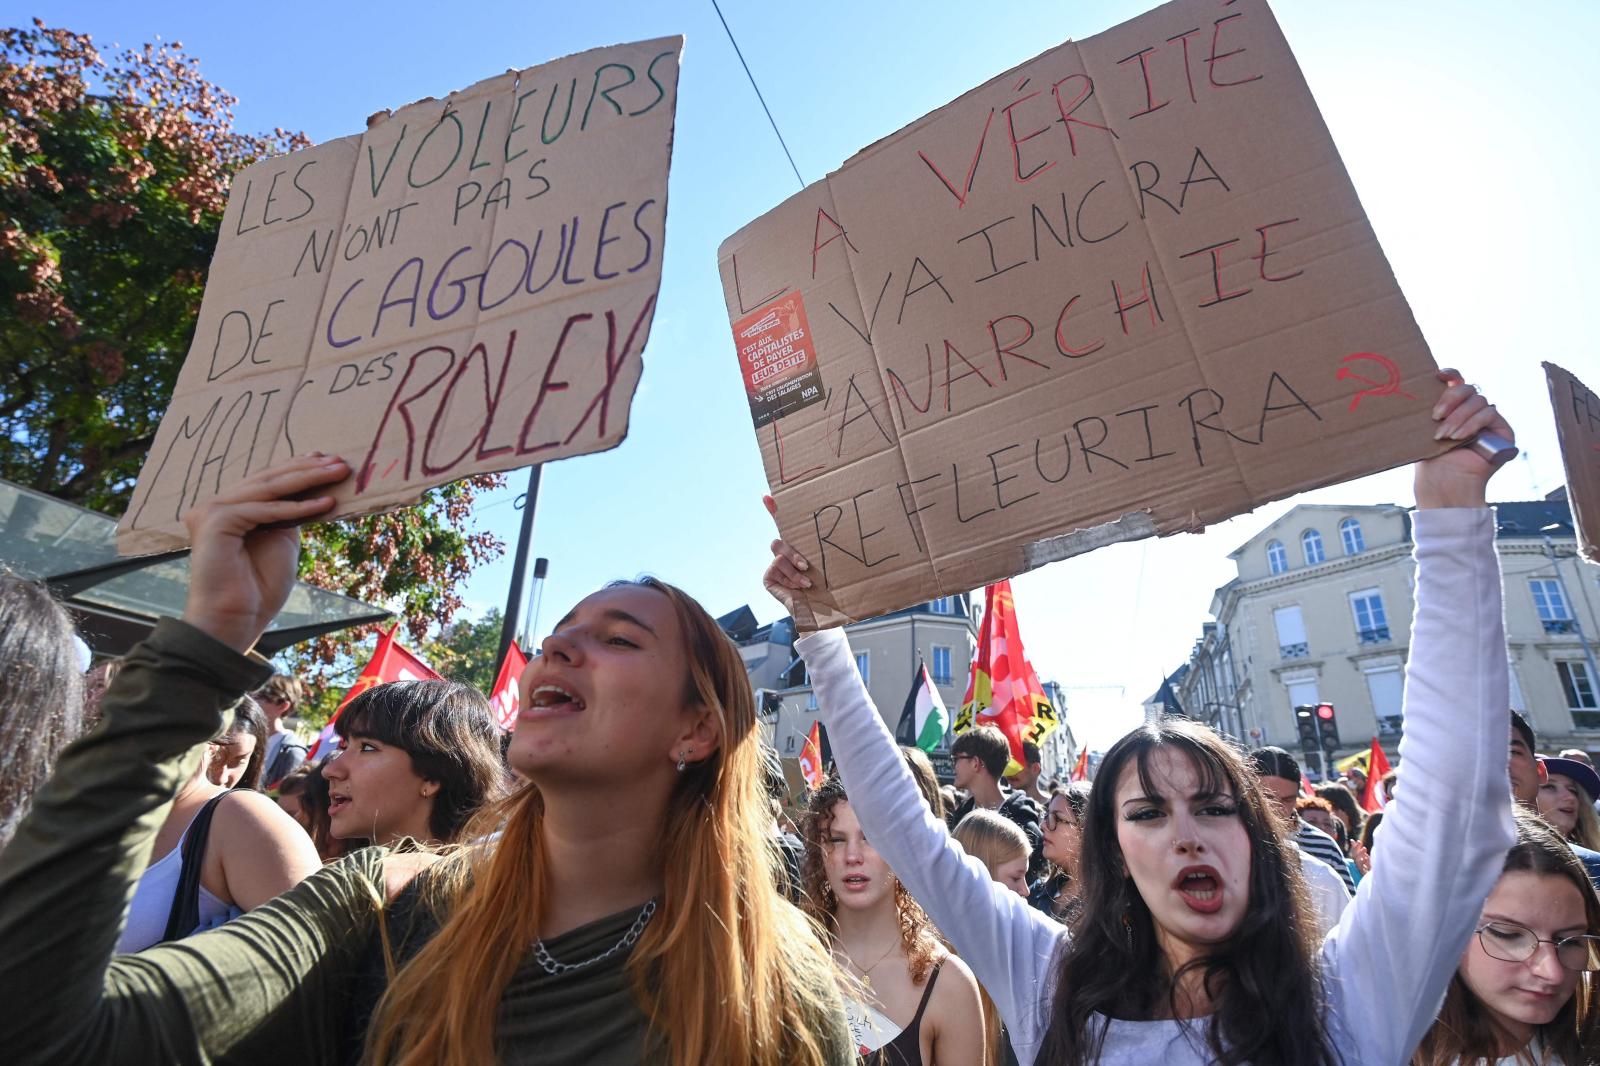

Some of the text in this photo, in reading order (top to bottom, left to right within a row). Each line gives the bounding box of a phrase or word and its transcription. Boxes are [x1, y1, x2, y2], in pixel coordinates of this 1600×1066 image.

[237, 51, 675, 236] LES VOLEURS
[293, 159, 551, 277] N'ONT PAS
[733, 0, 1264, 315] LA VÉRITÉ
[206, 199, 657, 382] DE CAGOULES
[828, 147, 1231, 346] VAINCRA
[328, 351, 398, 394] DES
[355, 293, 656, 496] ROLEX
[742, 335, 774, 355] C'EST AUX
[748, 328, 805, 362] CAPITALISTES
[753, 345, 794, 371] DE PAYER
[753, 351, 805, 383] LEUR DETTE
[773, 217, 1304, 485] L'ANARCHIE
[801, 385, 819, 399] NPA
[813, 371, 1323, 589] REFLEURIRA
